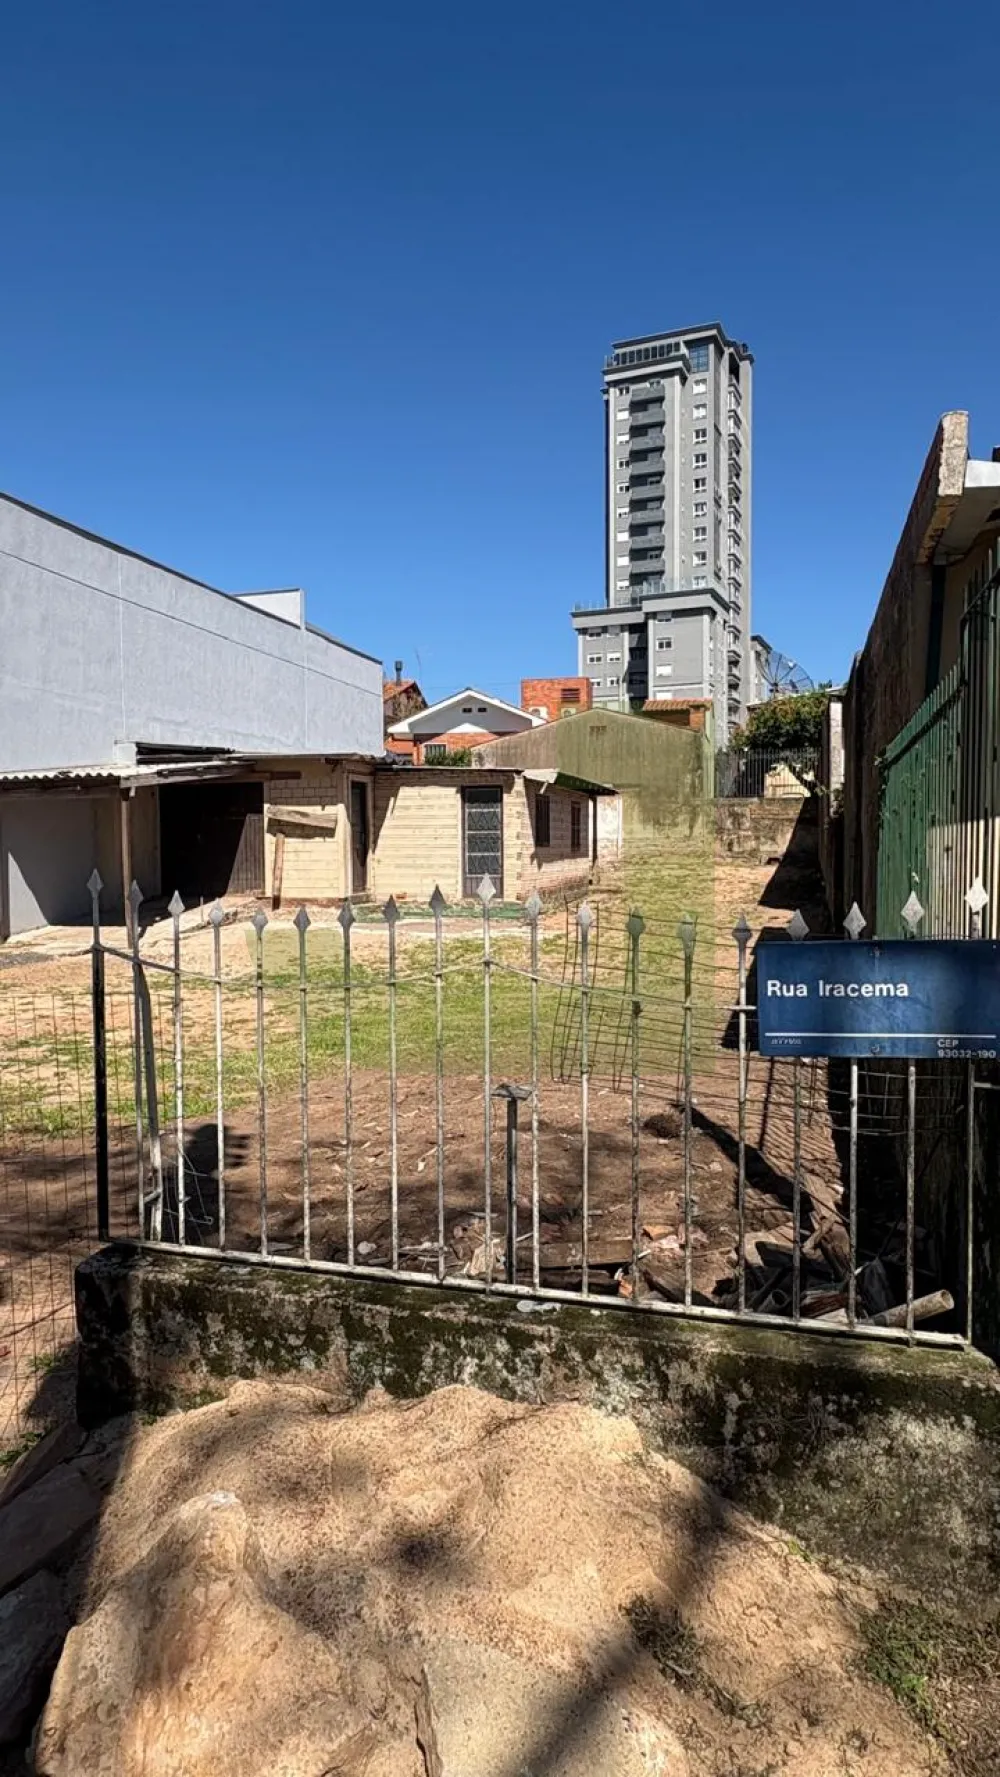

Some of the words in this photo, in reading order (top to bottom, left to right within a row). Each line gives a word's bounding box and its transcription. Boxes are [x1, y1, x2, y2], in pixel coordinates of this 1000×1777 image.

[767, 980, 807, 997] Rua
[818, 980, 909, 997] Iracema
[937, 1039, 959, 1048] CEP
